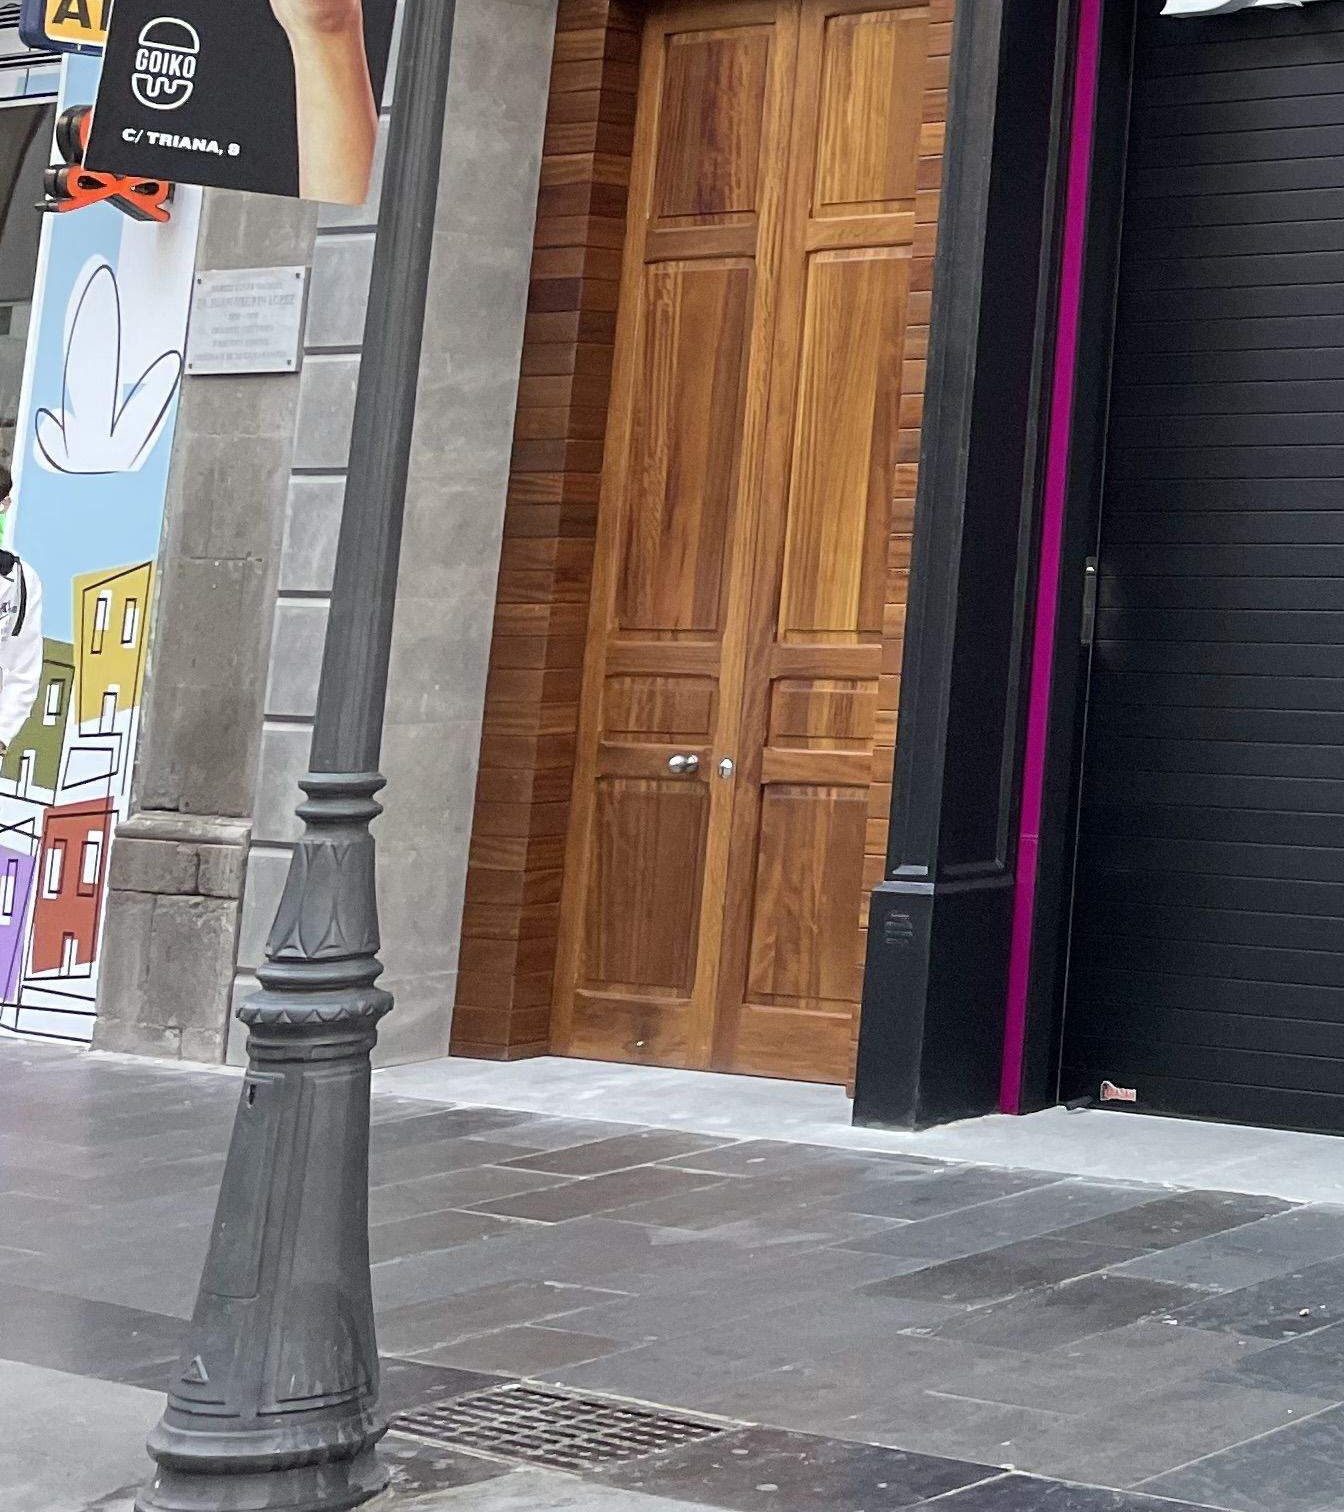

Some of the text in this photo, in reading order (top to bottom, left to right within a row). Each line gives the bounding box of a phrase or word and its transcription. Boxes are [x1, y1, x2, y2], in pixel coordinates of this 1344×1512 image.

[135, 48, 197, 79] GOIKO
[122, 128, 144, 144] C/
[146, 131, 224, 156] TRIANA,
